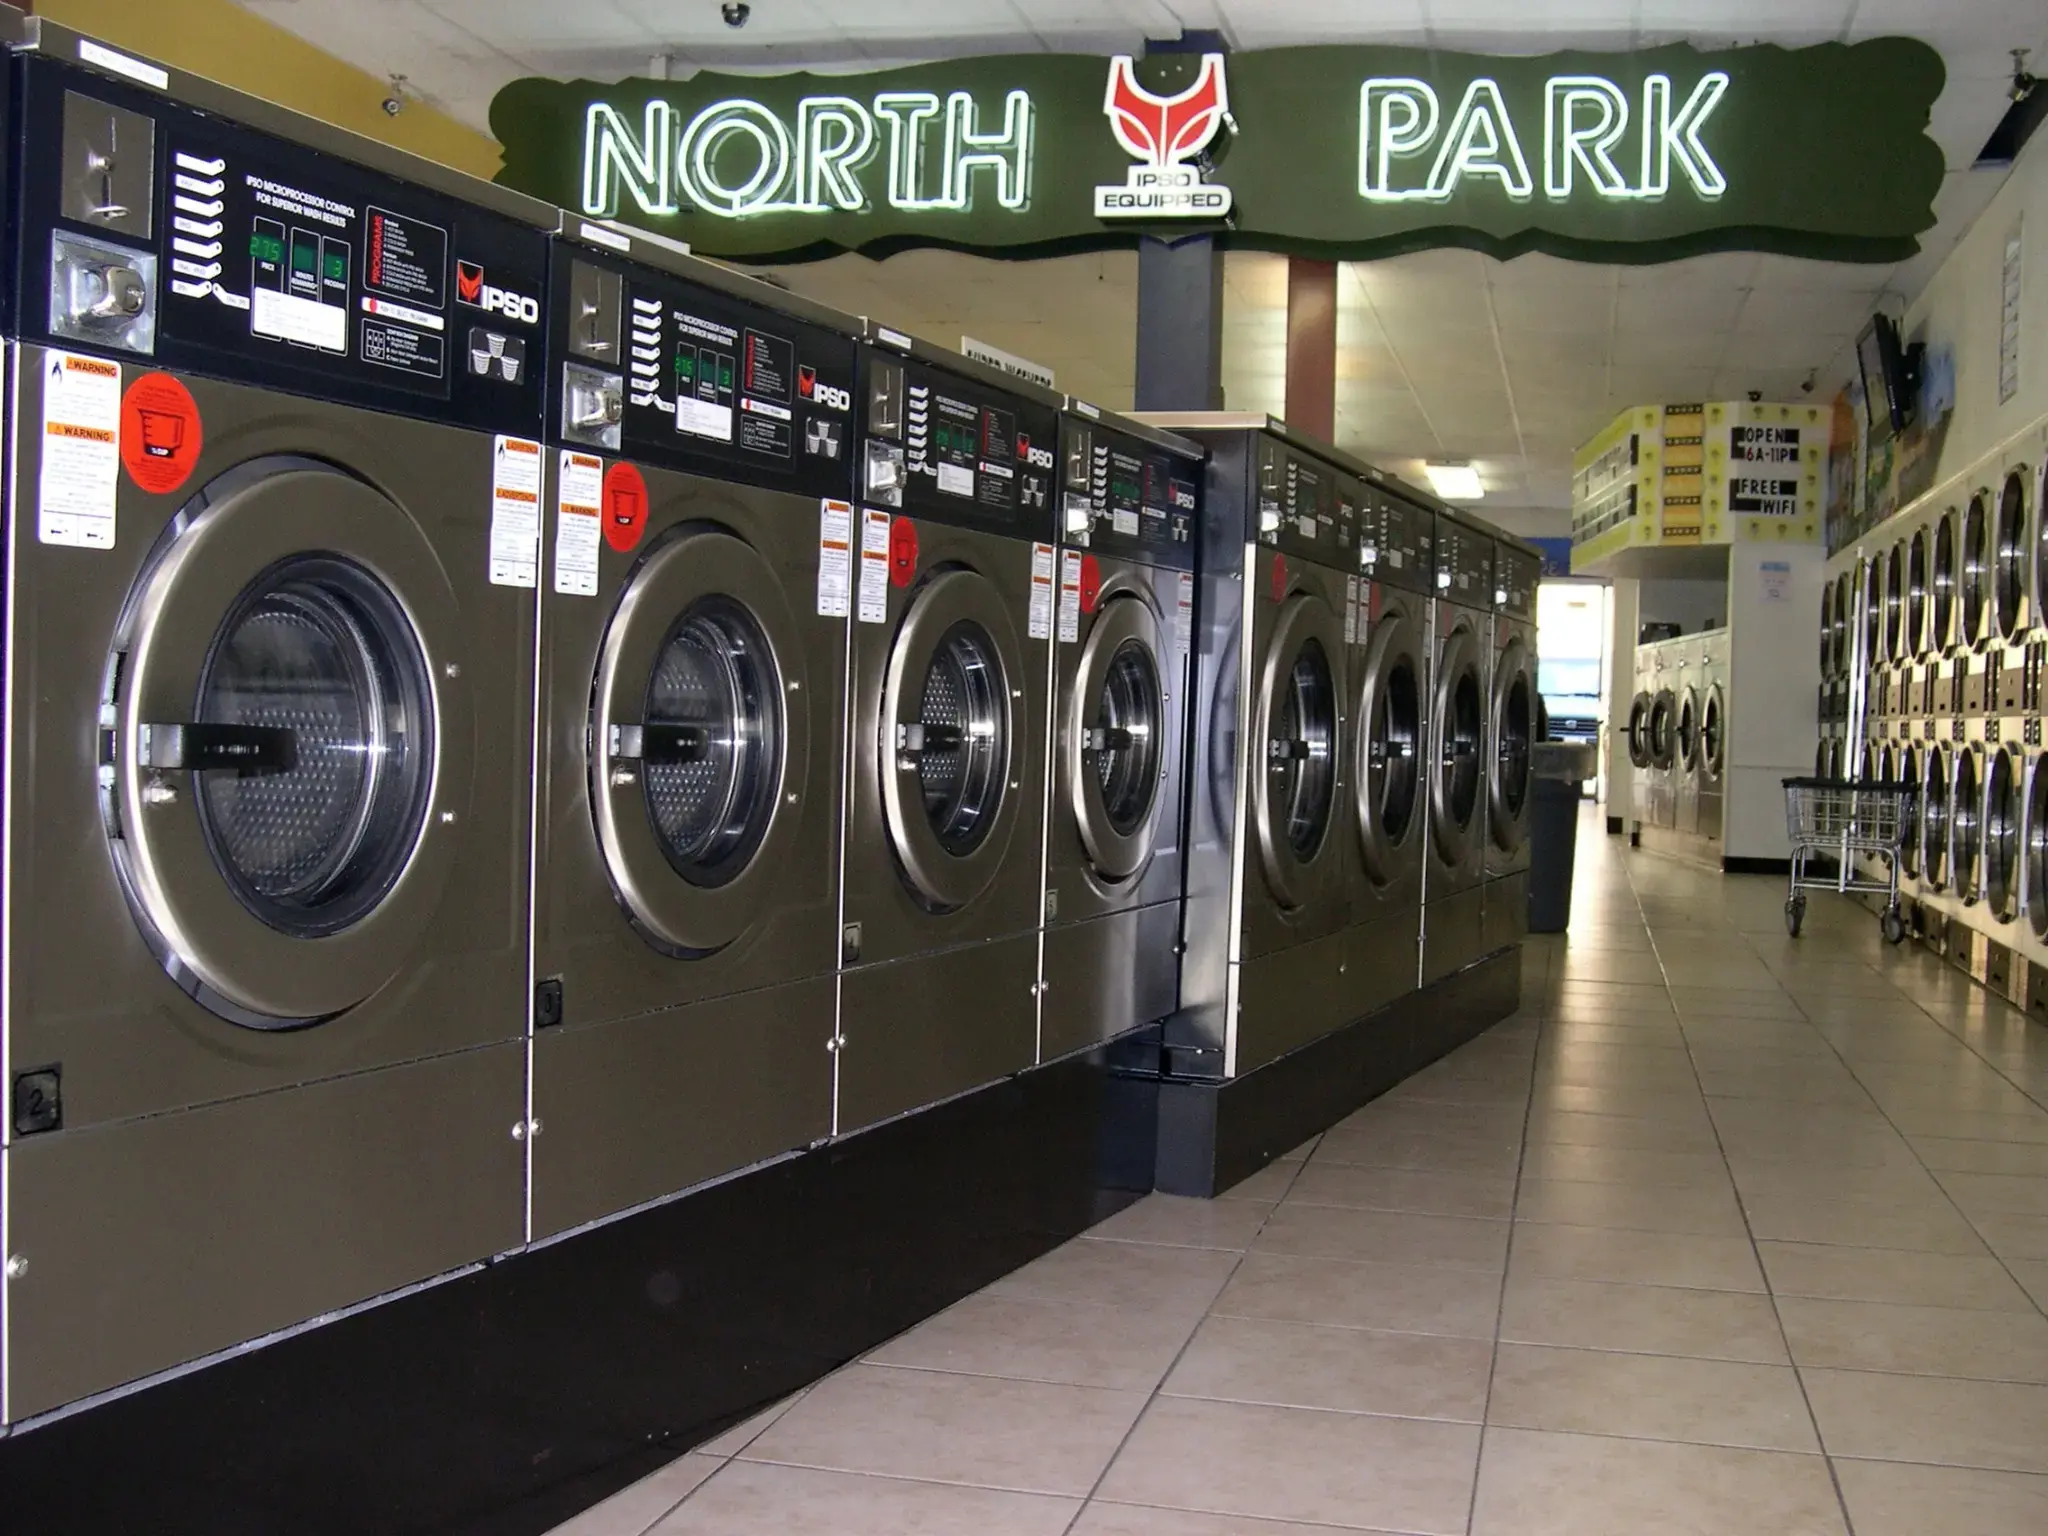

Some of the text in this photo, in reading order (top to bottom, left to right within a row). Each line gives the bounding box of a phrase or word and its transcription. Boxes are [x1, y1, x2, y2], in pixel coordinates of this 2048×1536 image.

[583, 72, 1730, 218] NORTH PARK
[1136, 173, 1191, 187] IPSO
[1104, 194, 1223, 208] EQUIPPED
[481, 284, 539, 324] IPSO
[74, 361, 117, 377] WARNING
[814, 382, 850, 411] IPSO
[64, 426, 110, 442] WARNING
[1746, 427, 1783, 443] OPEN
[1027, 446, 1053, 469] IPSO
[1741, 479, 1778, 494] FREE
[1761, 499, 1796, 515] WIFI
